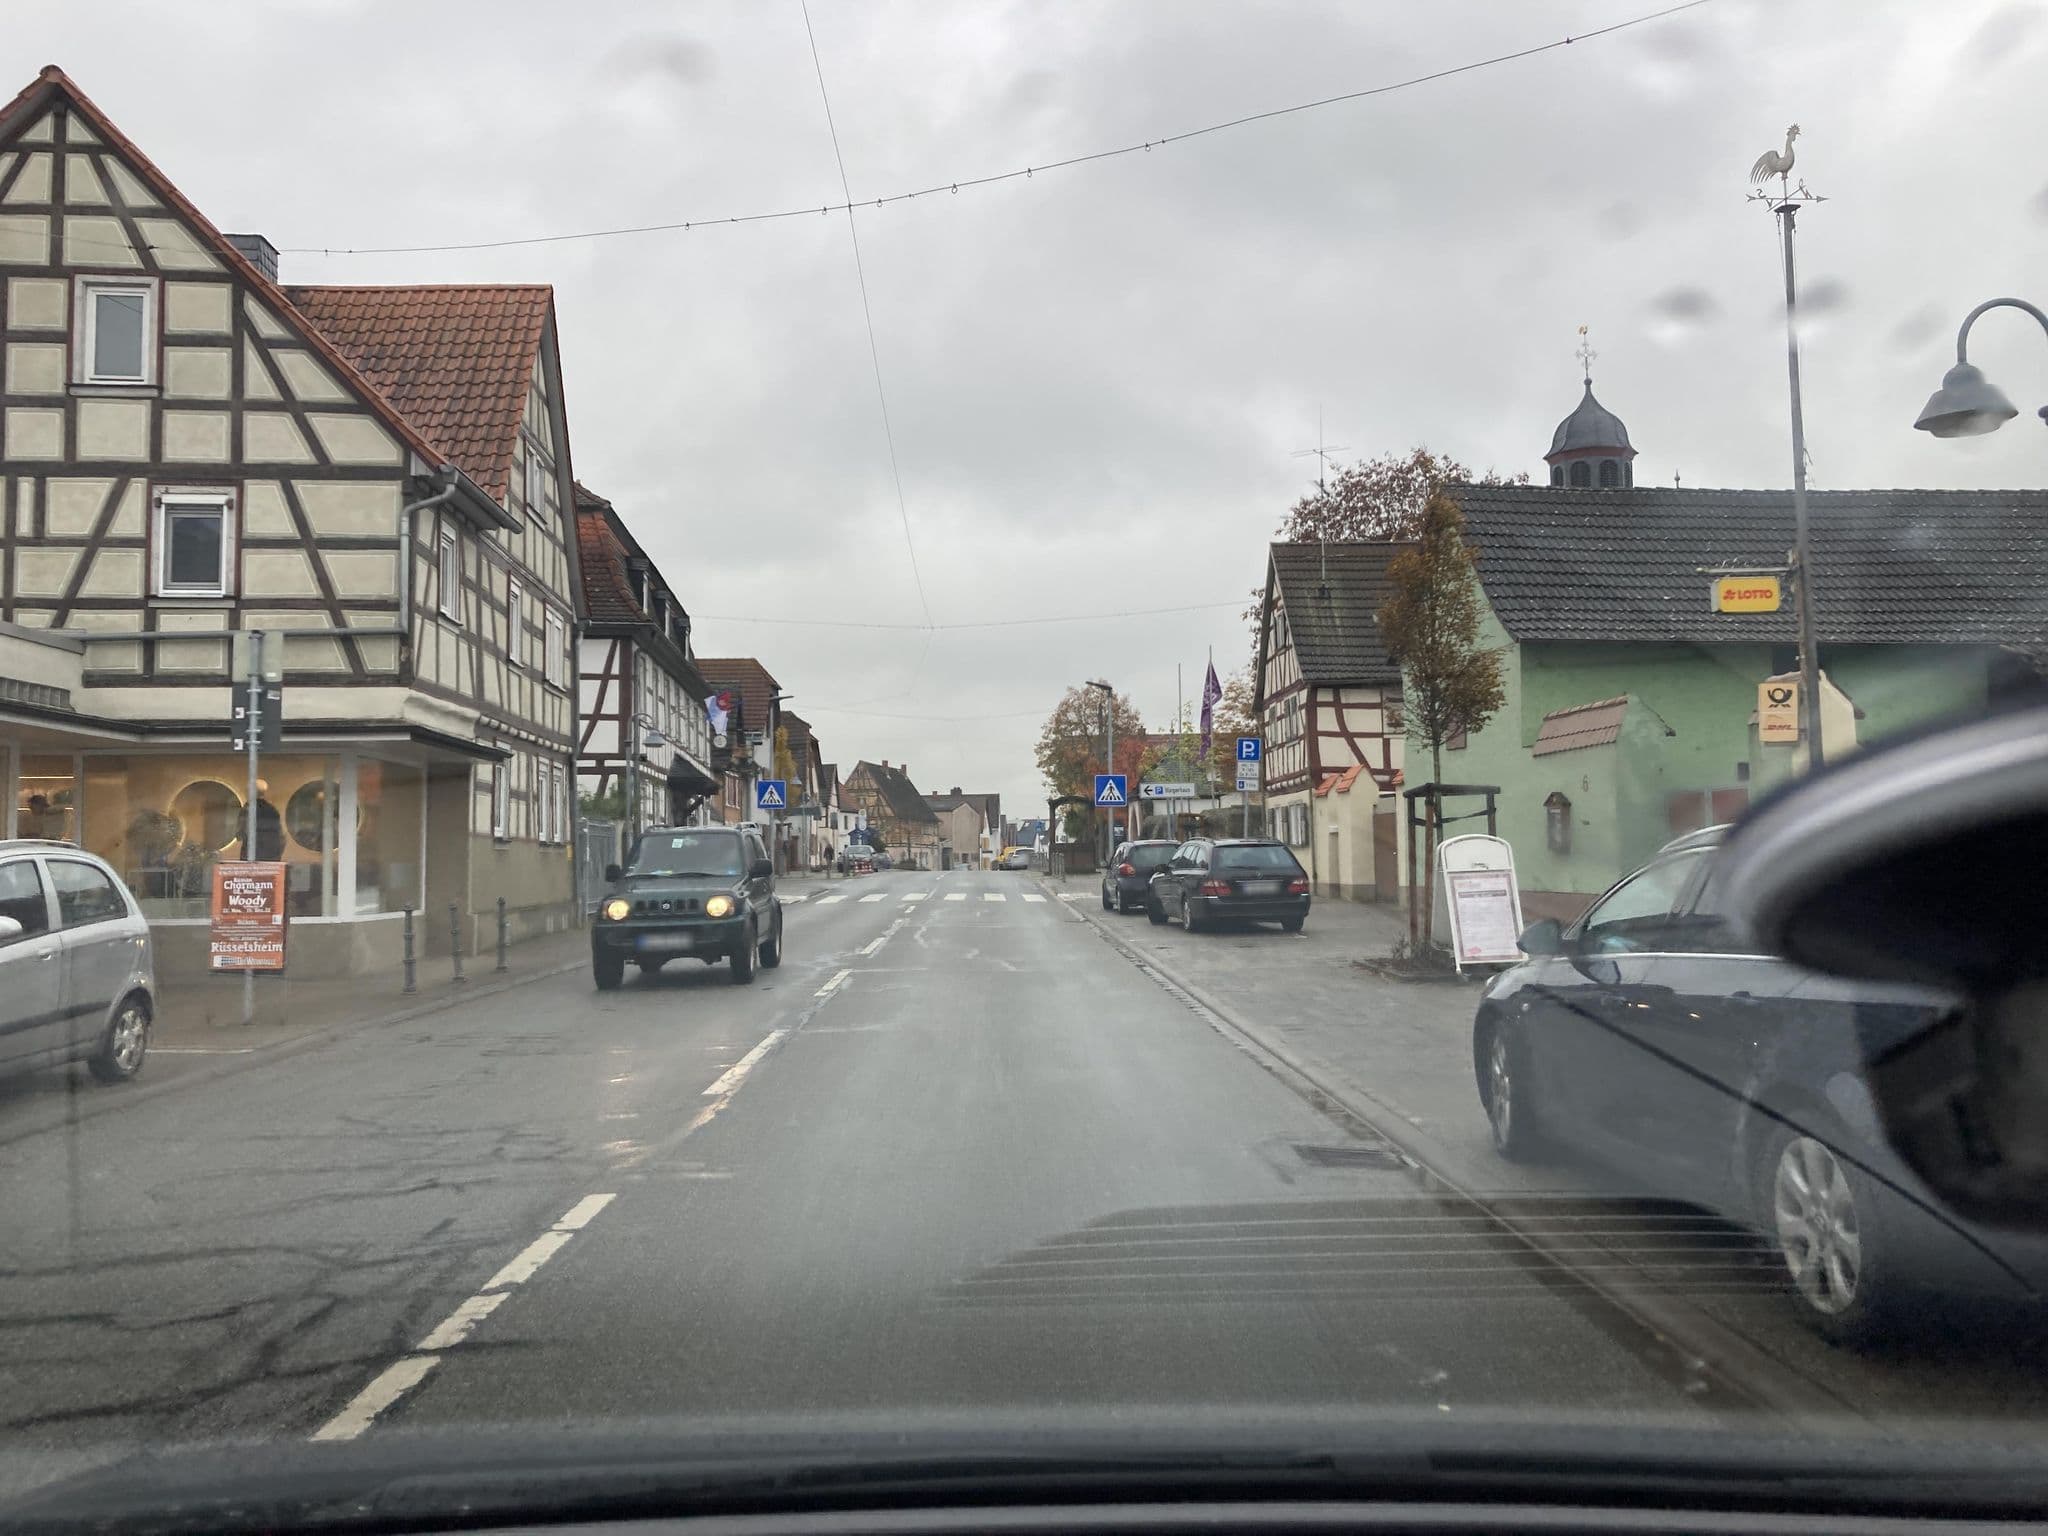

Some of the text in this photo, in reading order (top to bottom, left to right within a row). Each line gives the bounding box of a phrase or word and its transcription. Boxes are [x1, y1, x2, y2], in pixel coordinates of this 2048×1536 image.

[1737, 589, 1773, 599] LOTTO
[1583, 774, 1589, 792] 6
[224, 880, 273, 890] Chormann
[229, 895, 267, 907] Woody
[211, 941, 283, 952] Rüsselsheim
